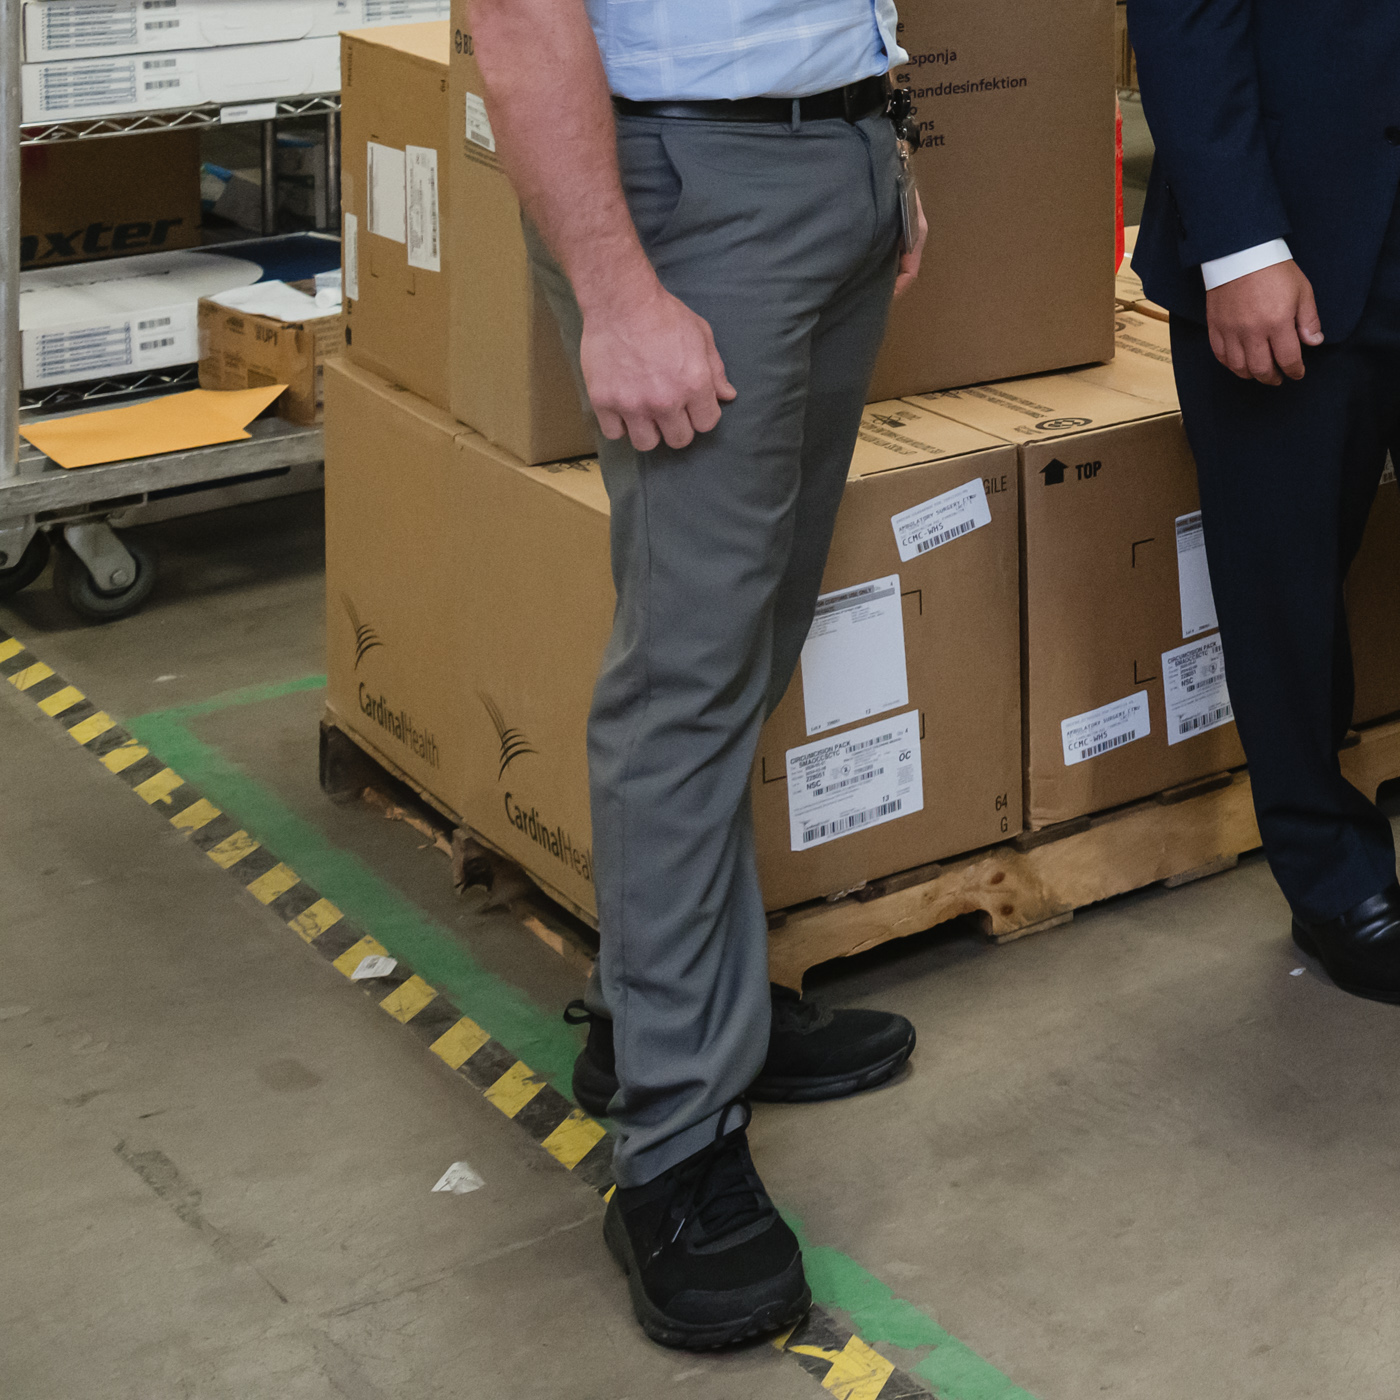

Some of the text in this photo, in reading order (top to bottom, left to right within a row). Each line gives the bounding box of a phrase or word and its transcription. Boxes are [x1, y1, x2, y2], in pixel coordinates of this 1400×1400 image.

[20, 217, 183, 263] axter
[1076, 461, 1102, 480] TOP
[983, 476, 1007, 495] GILE
[1181, 677, 1193, 687] NSC
[358, 681, 440, 770] CardinalHealth
[834, 741, 851, 750] PACK
[899, 750, 911, 762] OC
[806, 779, 822, 790] NSC
[995, 793, 1008, 811] 64
[1000, 816, 1008, 833] G
[505, 791, 593, 882] CardinalHeal
